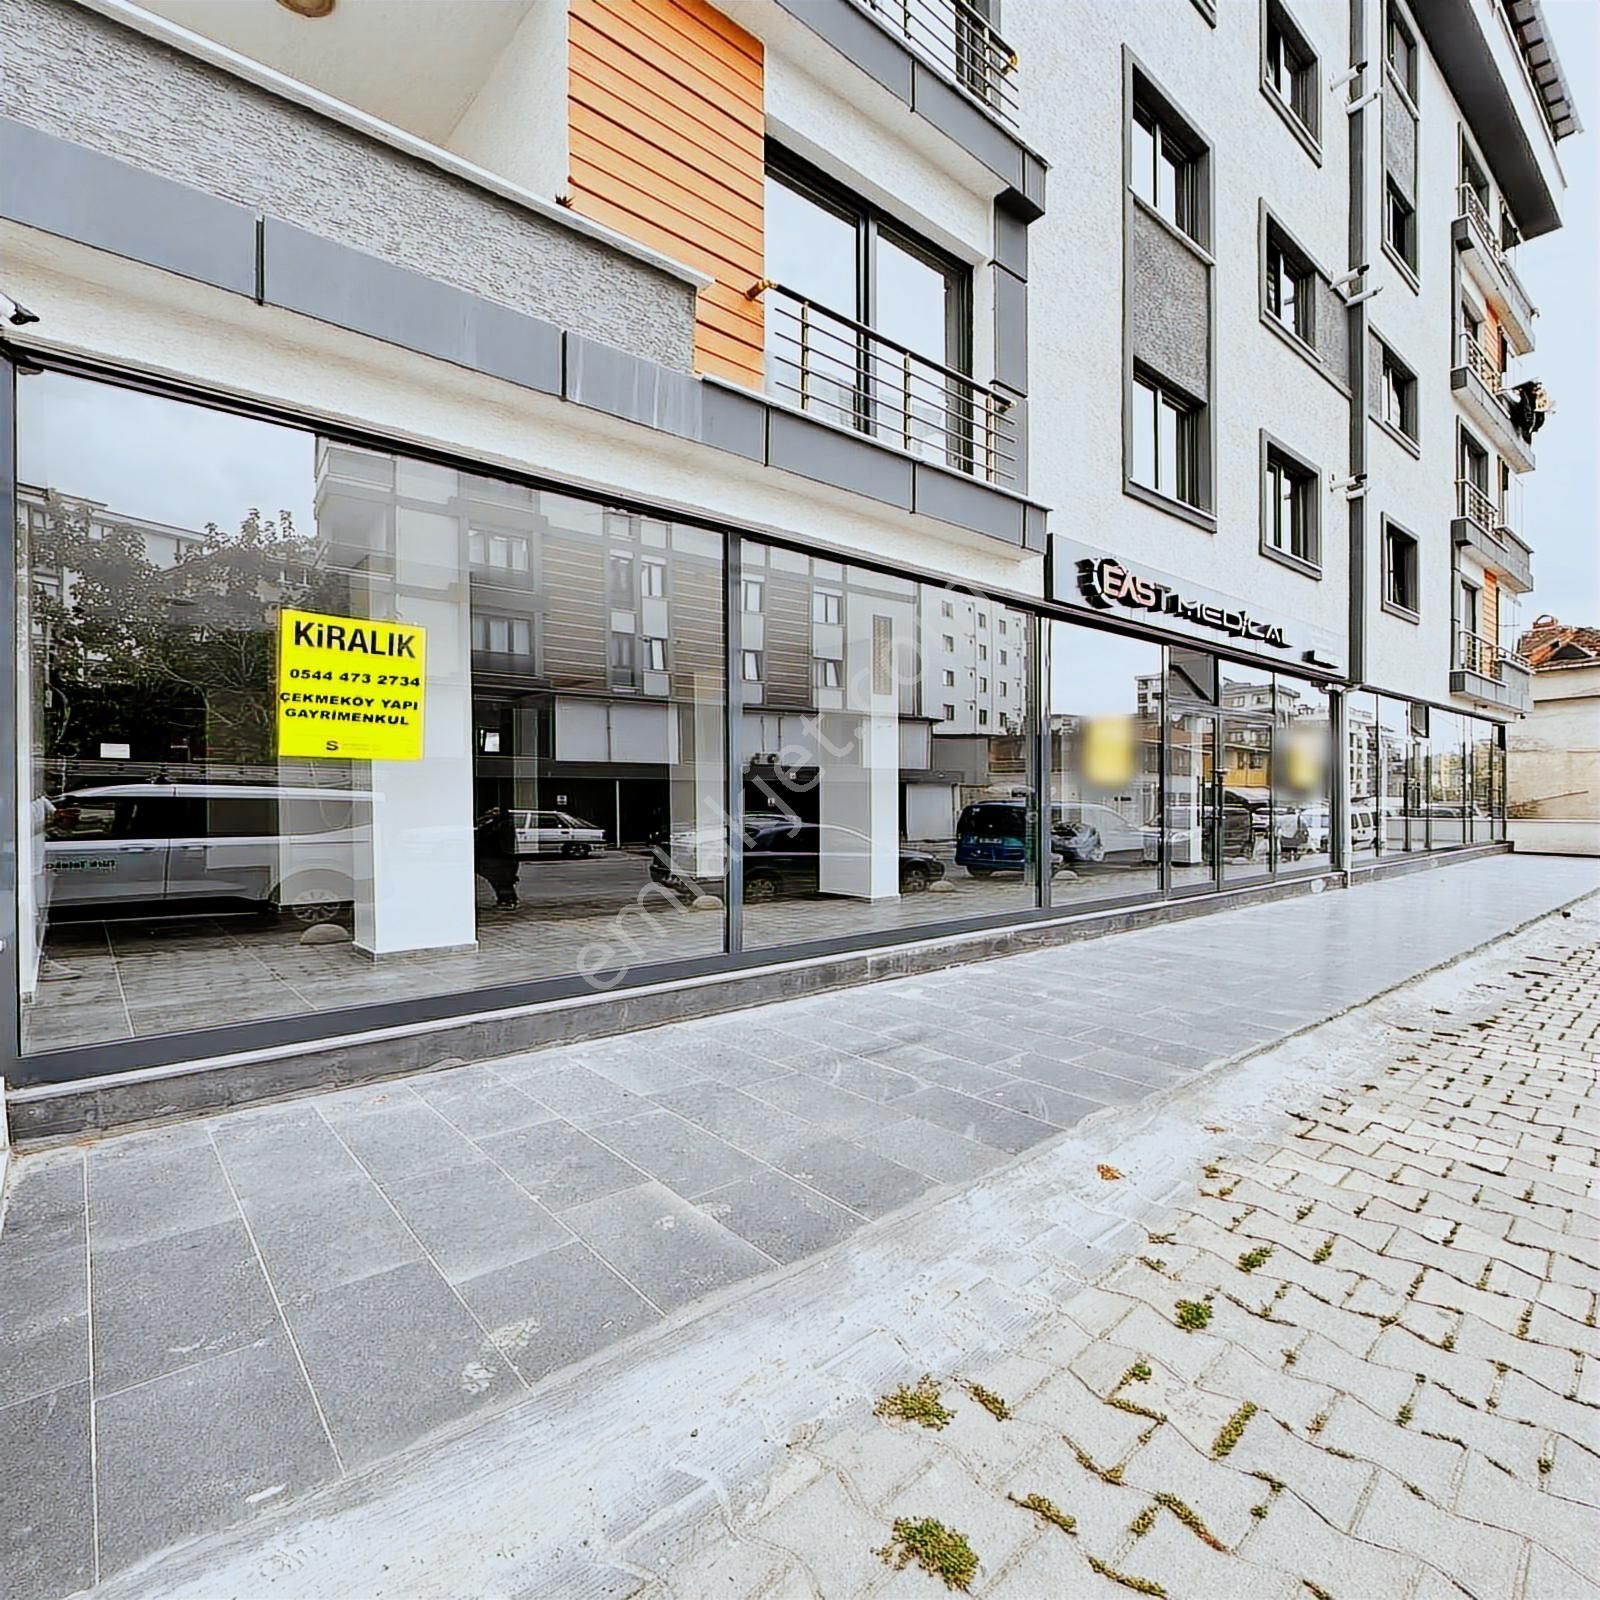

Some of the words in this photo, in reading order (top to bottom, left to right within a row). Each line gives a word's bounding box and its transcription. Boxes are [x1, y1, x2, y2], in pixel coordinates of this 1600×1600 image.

[1103, 563, 1173, 613] EAST
[1177, 594, 1291, 648] MEDICAL
[290, 669, 332, 681] 0544
[339, 672, 371, 683] 473
[377, 675, 420, 686] 2734
[381, 699, 418, 711] YAPI
